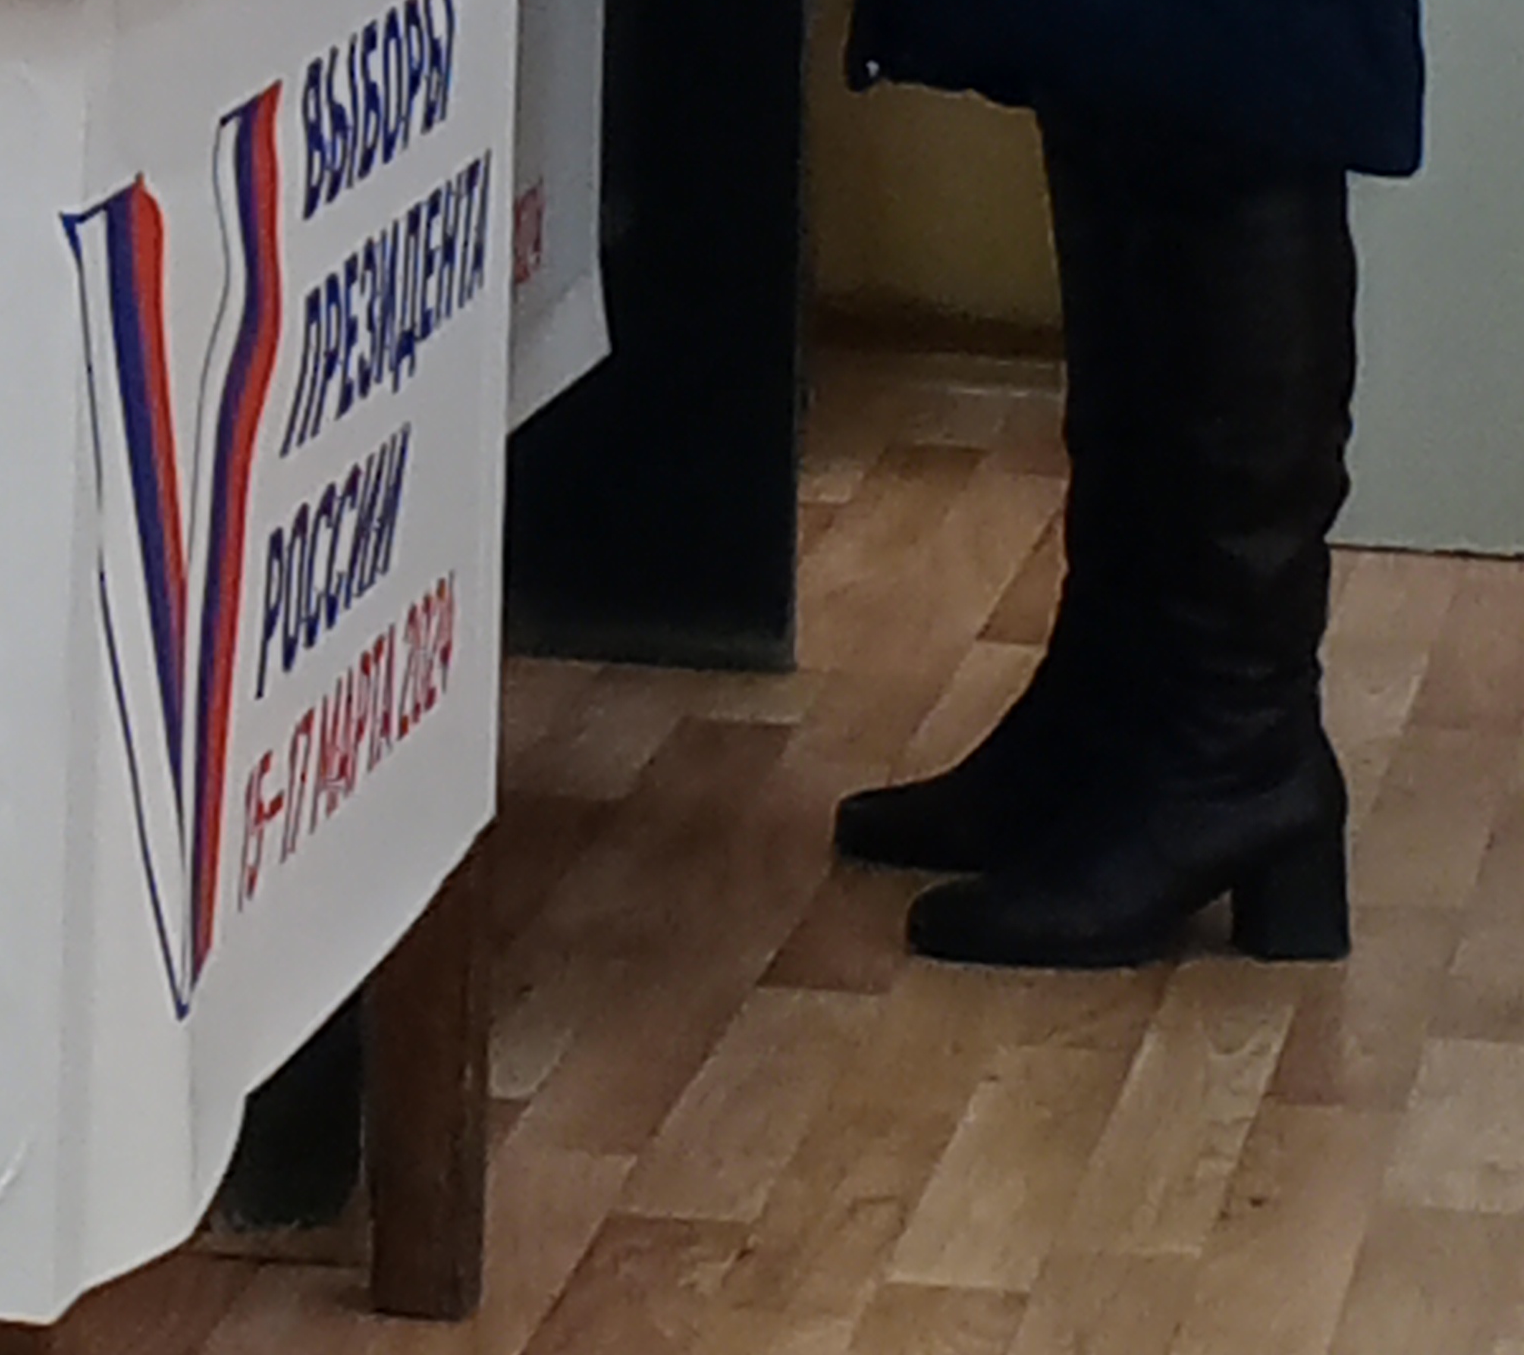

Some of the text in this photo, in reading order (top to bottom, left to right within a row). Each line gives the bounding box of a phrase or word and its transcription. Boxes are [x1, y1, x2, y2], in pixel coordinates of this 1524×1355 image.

[279, 147, 492, 459] ПРЕЗИДЕНТА
[255, 421, 412, 700] РОССИИ
[309, 623, 395, 835] МАРТА
[398, 570, 455, 741] 2024
